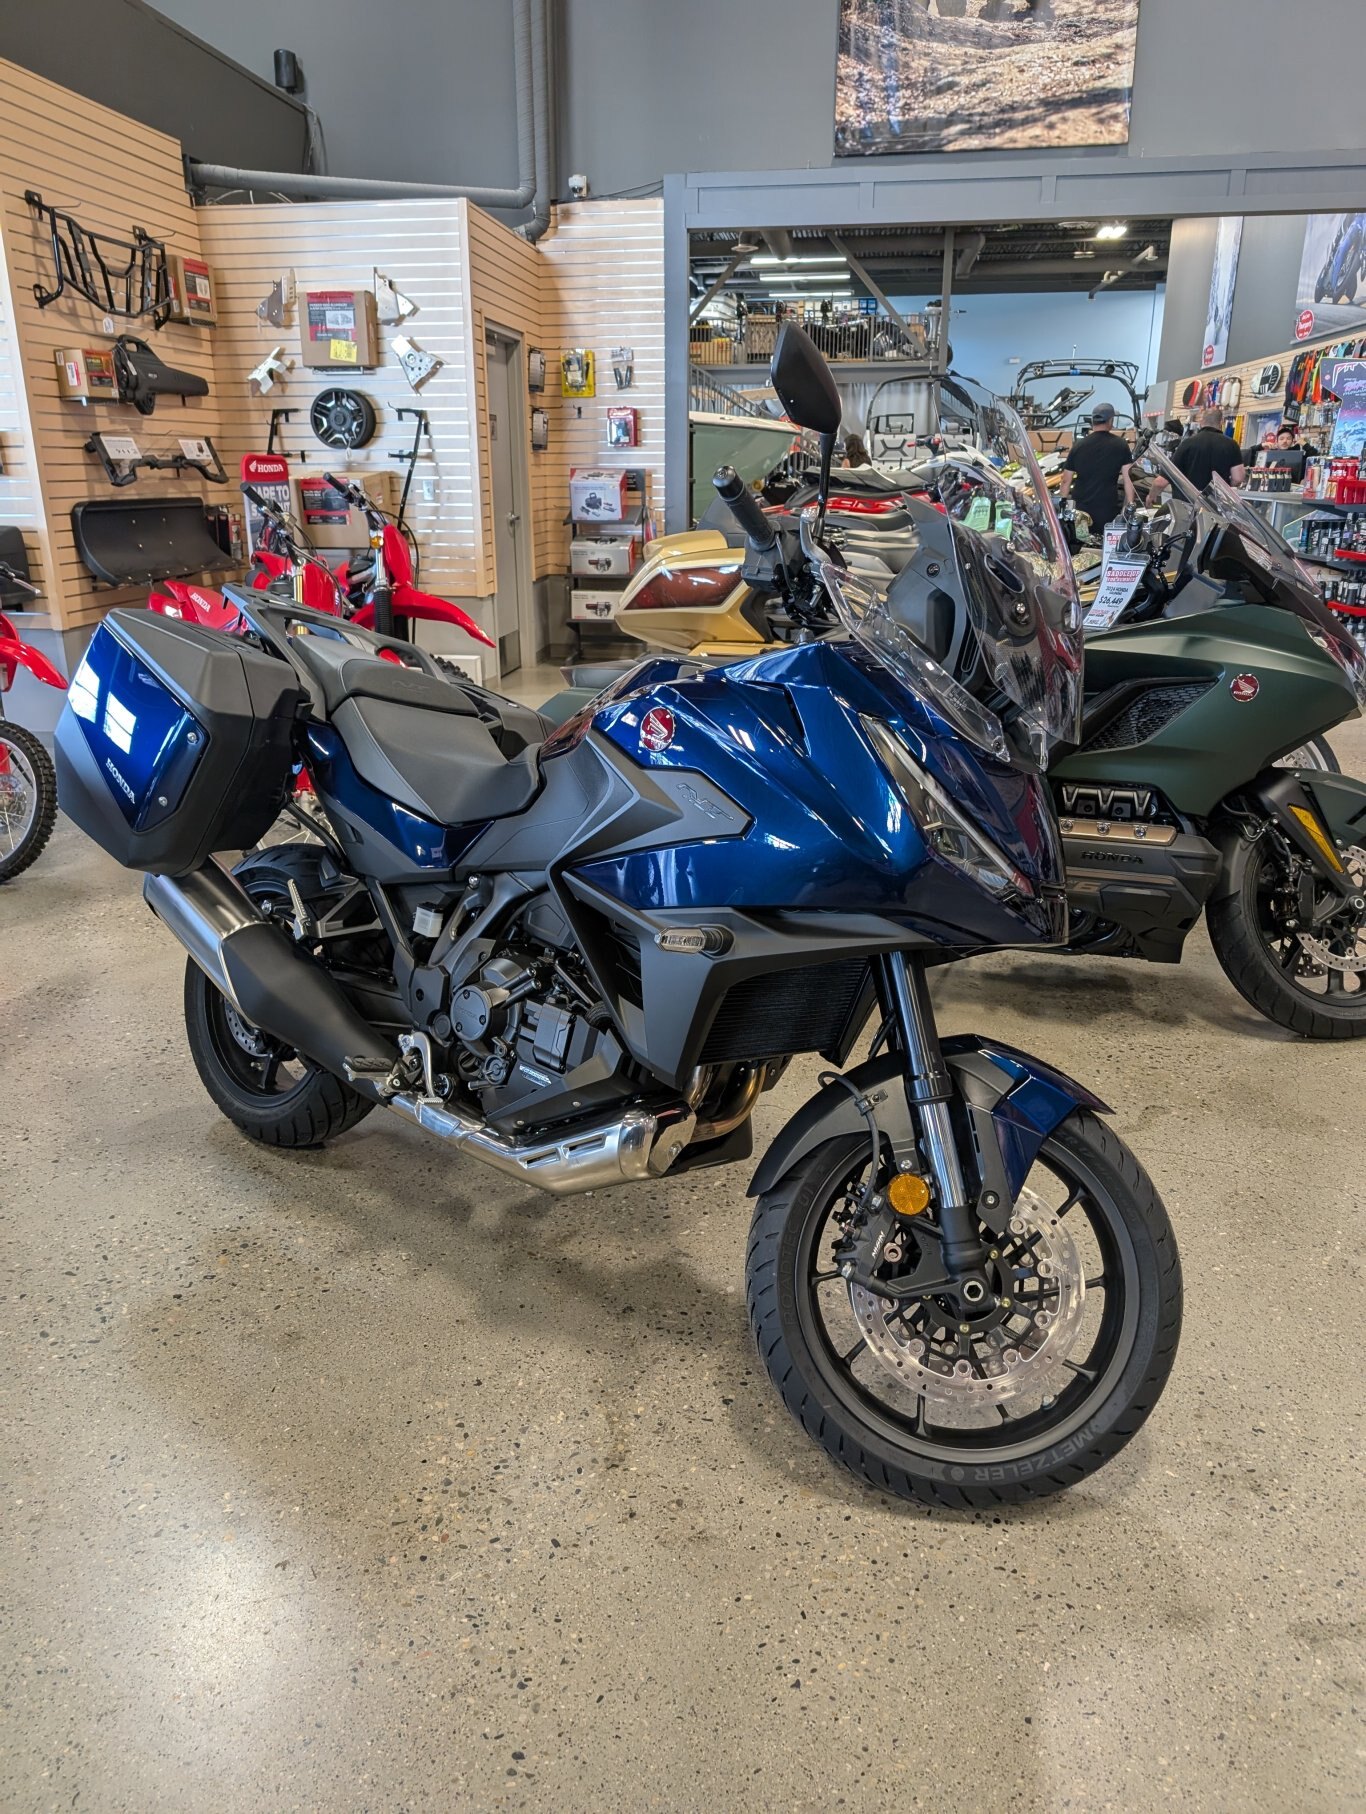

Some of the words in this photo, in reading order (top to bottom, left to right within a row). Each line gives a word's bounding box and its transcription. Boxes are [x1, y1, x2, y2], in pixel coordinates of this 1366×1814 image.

[257, 463, 284, 473] HONDA
[190, 592, 211, 613] HONDA
[105, 757, 135, 805] HONDA
[1081, 851, 1143, 864] HONDA
[974, 1421, 1095, 1482] METZELER
